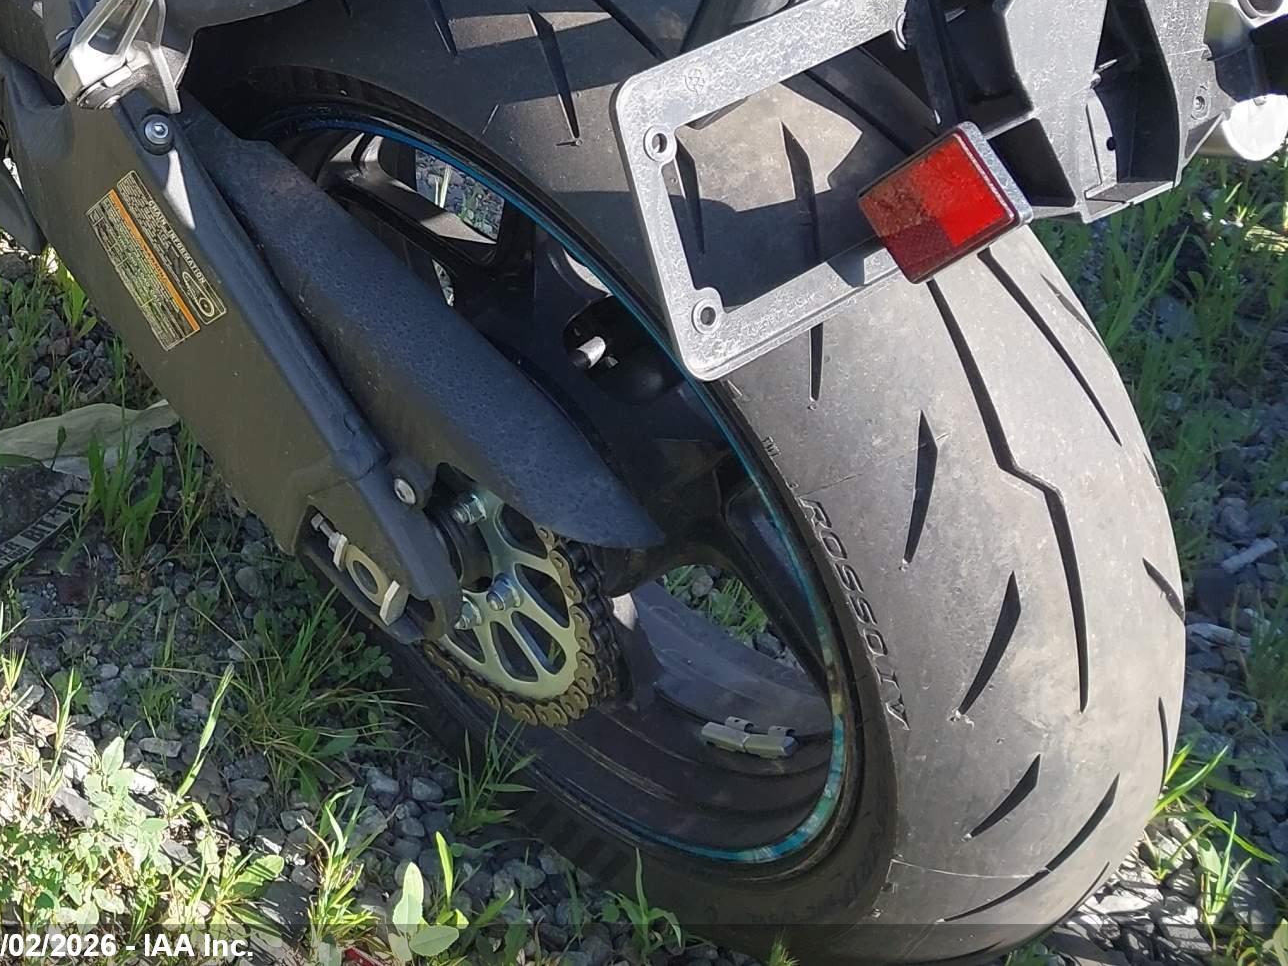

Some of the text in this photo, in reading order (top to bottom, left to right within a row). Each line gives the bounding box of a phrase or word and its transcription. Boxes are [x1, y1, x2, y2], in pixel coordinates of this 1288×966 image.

[148, 200, 167, 226] CHAIN
[167, 229, 206, 285] INFORMATION
[798, 498, 889, 657] ROSSO
